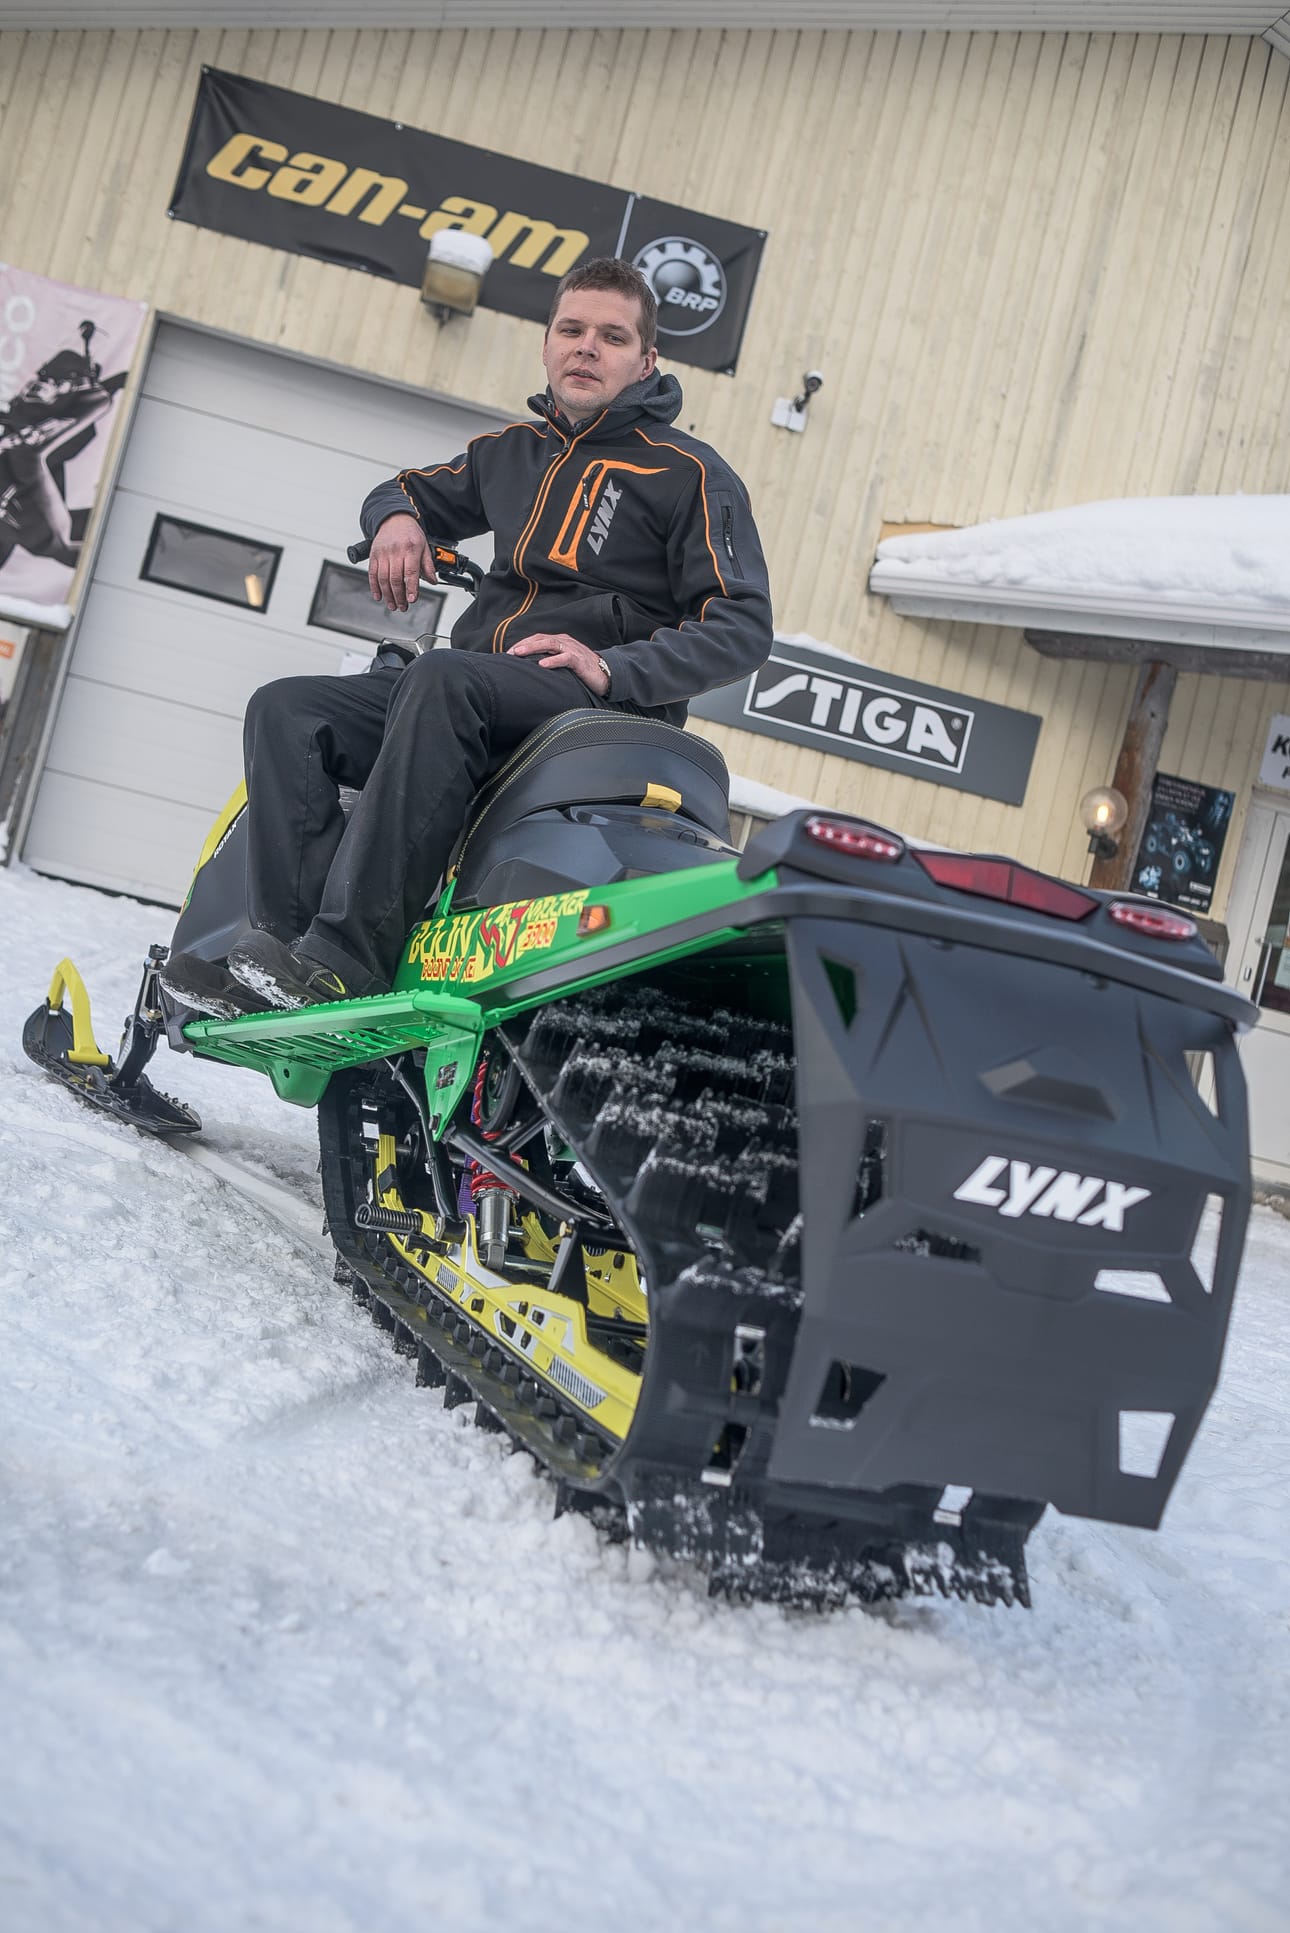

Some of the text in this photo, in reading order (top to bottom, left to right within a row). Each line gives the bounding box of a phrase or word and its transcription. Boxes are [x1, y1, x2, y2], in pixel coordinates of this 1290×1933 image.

[206, 132, 590, 277] can-am
[664, 287, 719, 312] BRP
[586, 478, 618, 555] LYNX
[755, 673, 958, 763] STIGA
[213, 823, 237, 859] ROTAX
[953, 1155, 1151, 1231] LYNX
